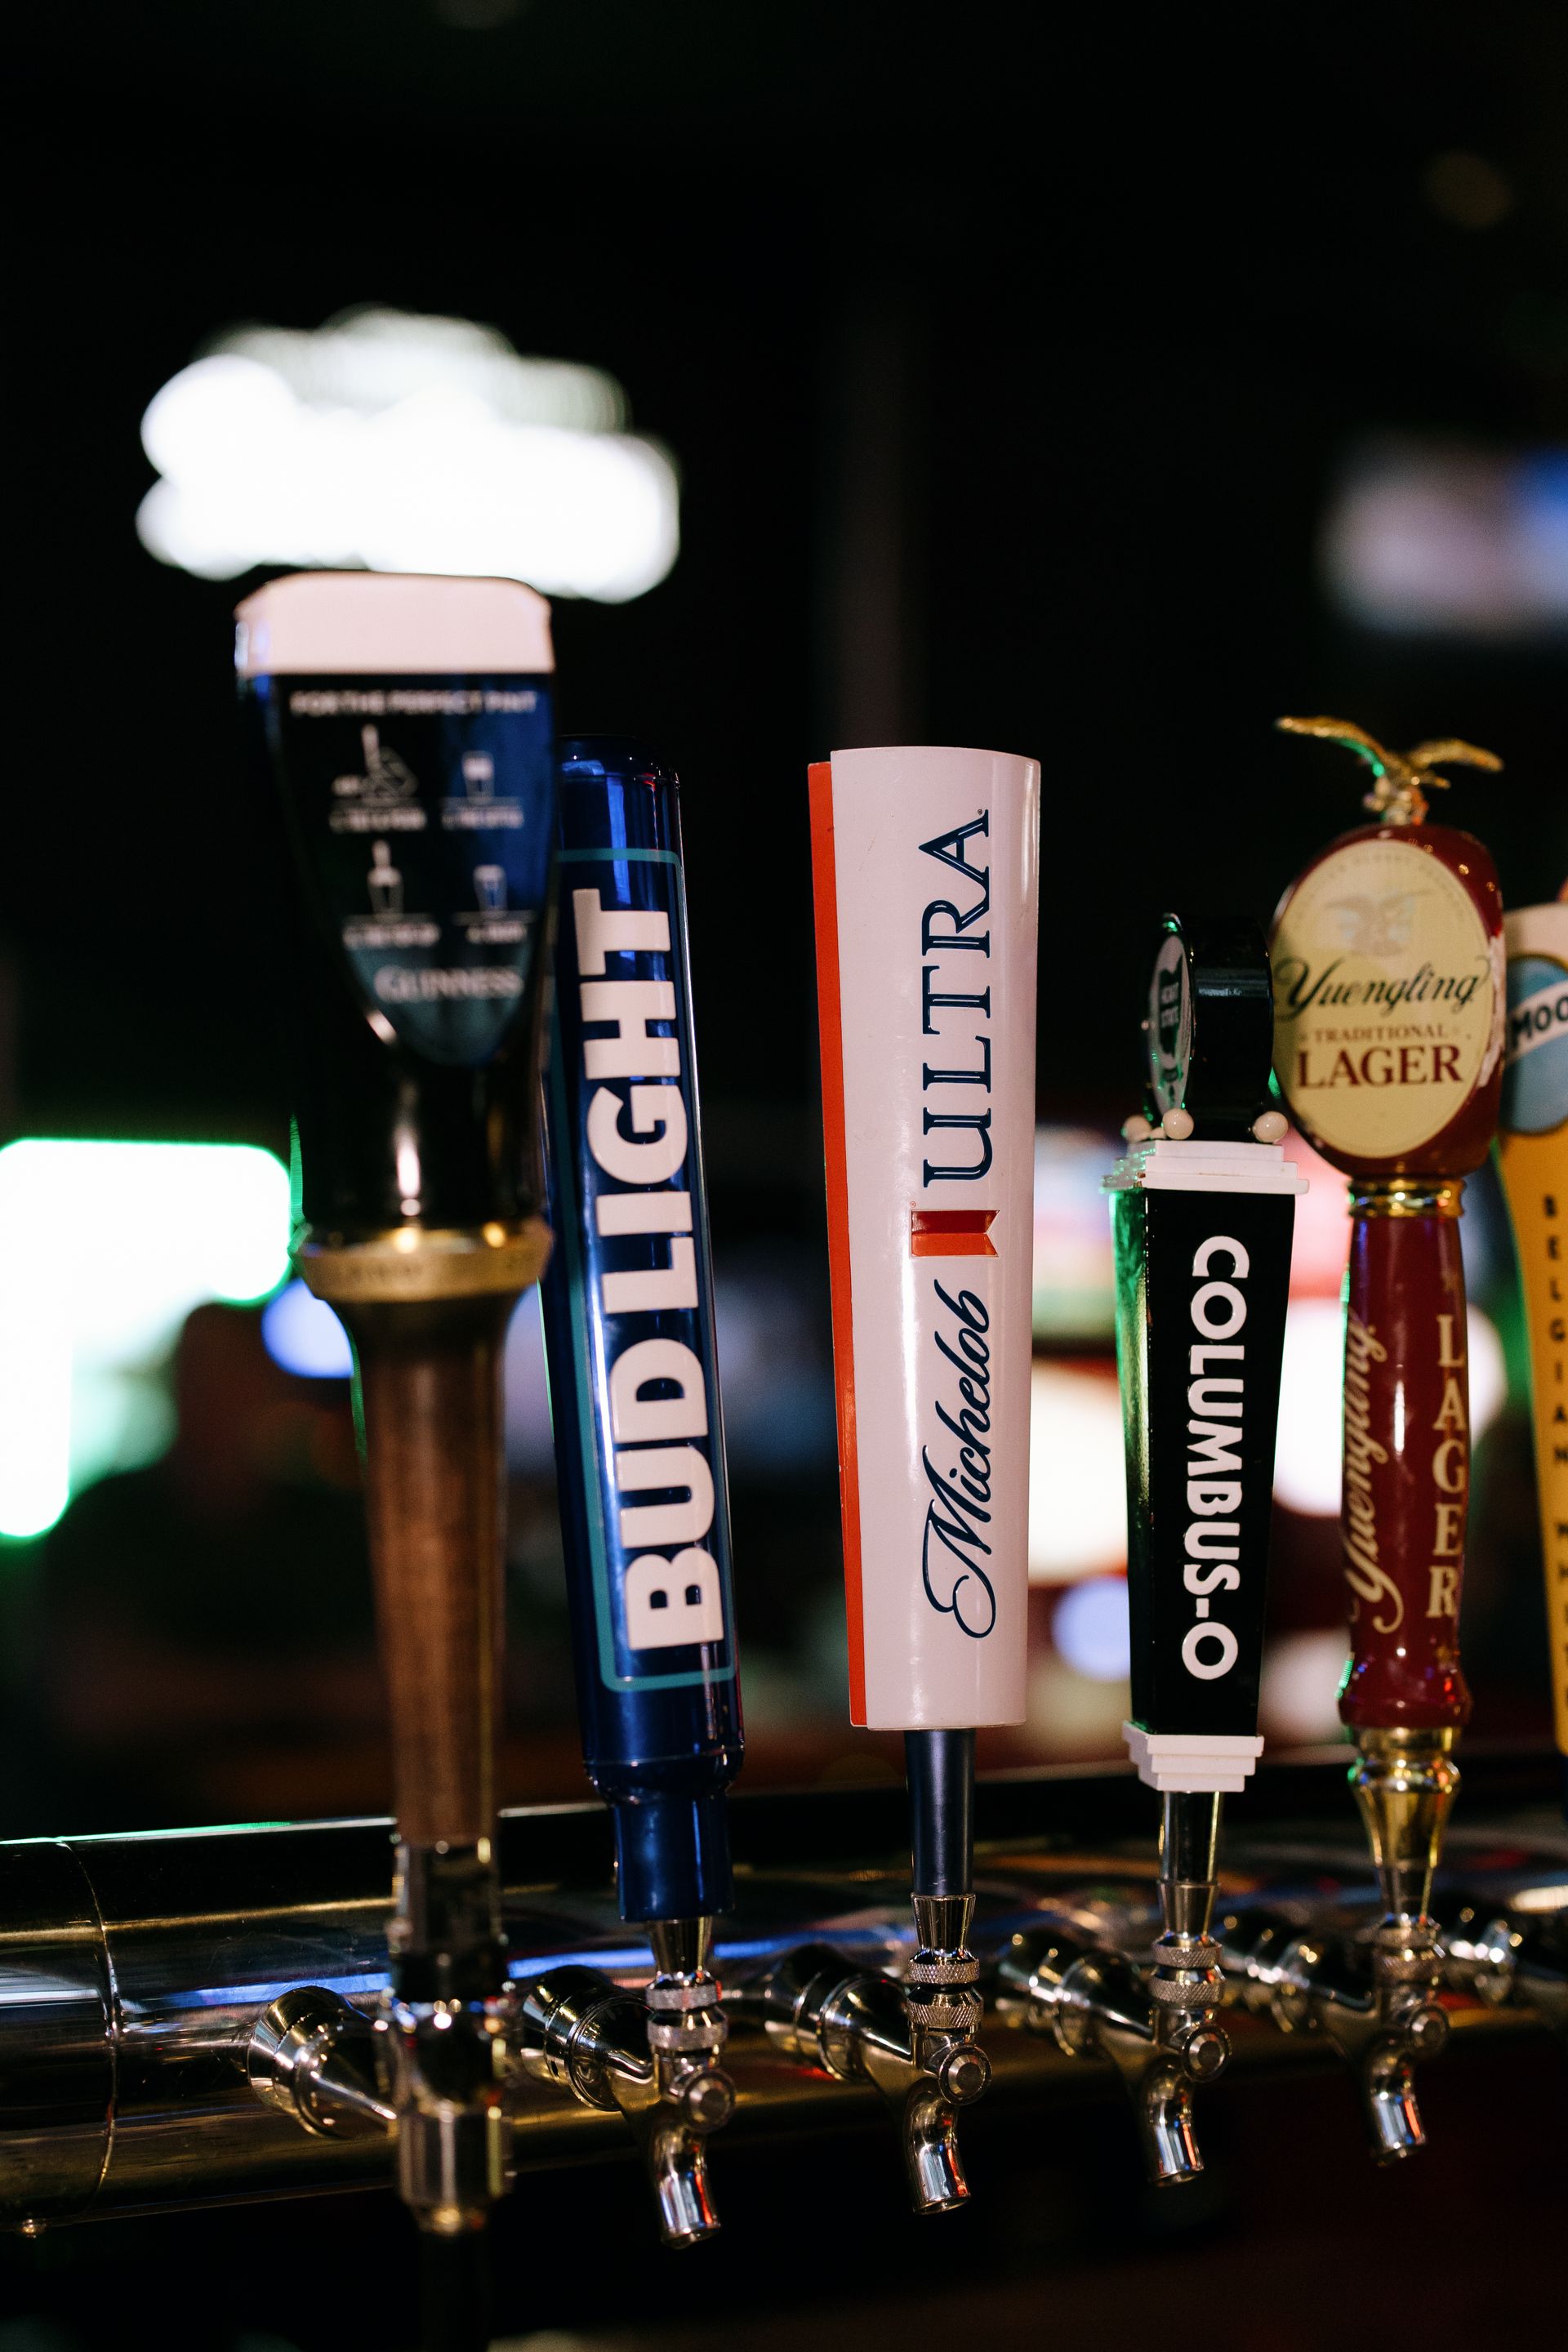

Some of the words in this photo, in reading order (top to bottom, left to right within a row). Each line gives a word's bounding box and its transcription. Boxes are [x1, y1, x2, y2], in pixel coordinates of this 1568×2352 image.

[572, 889, 697, 1313] LIGHT
[919, 808, 993, 1187] ULTRA
[1274, 956, 1490, 1020] Yuengling
[1298, 1045, 1463, 1088] LAGER
[1316, 1024, 1450, 1042] TRADITIONAL
[612, 1338, 724, 1650] BUD
[921, 1279, 996, 1638] Michelob
[1181, 1236, 1250, 1680] COLUMBUS-O
[1428, 1314, 1467, 1618] LAGER
